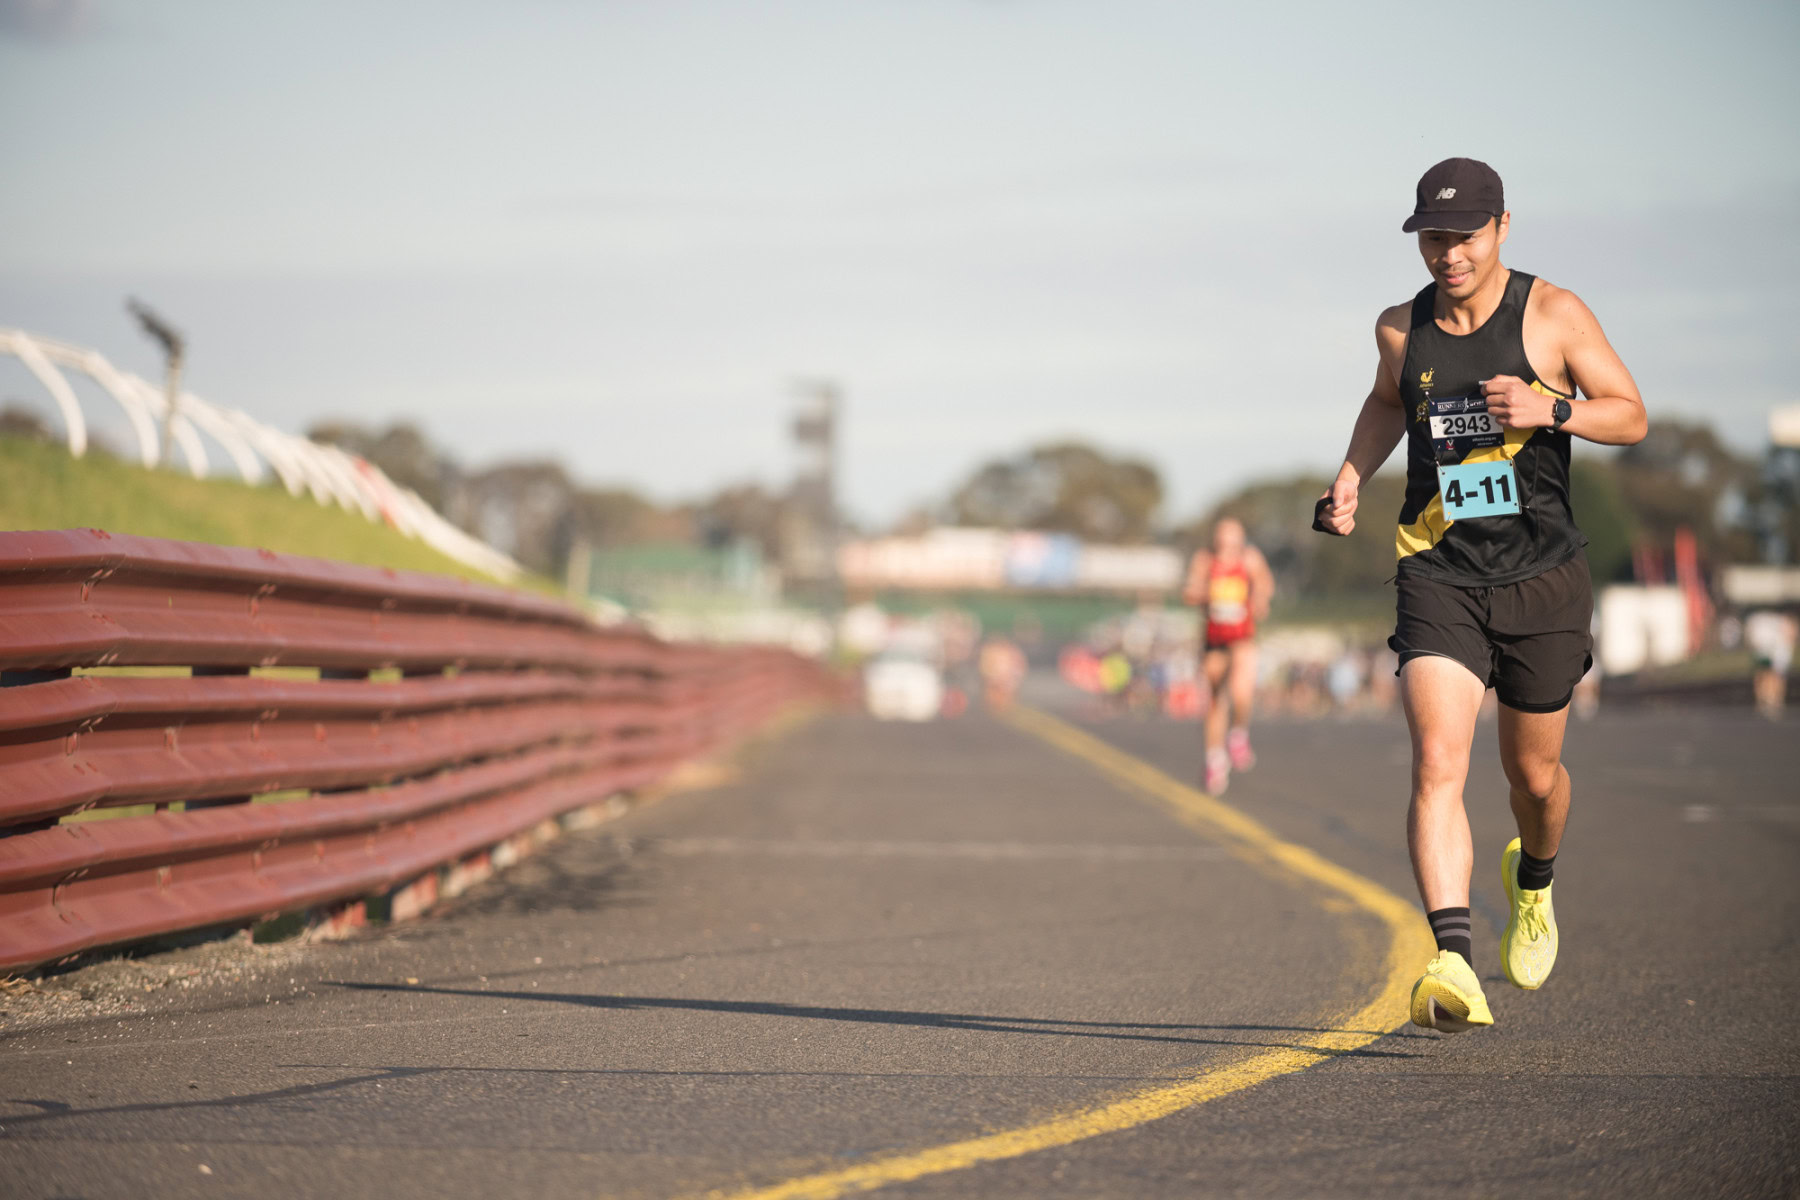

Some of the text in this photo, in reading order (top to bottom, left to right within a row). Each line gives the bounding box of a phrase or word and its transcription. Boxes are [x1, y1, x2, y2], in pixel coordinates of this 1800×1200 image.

[1436, 188, 1456, 200] NB
[1442, 415, 1491, 436] 2943
[1445, 474, 1512, 508] 4-11
